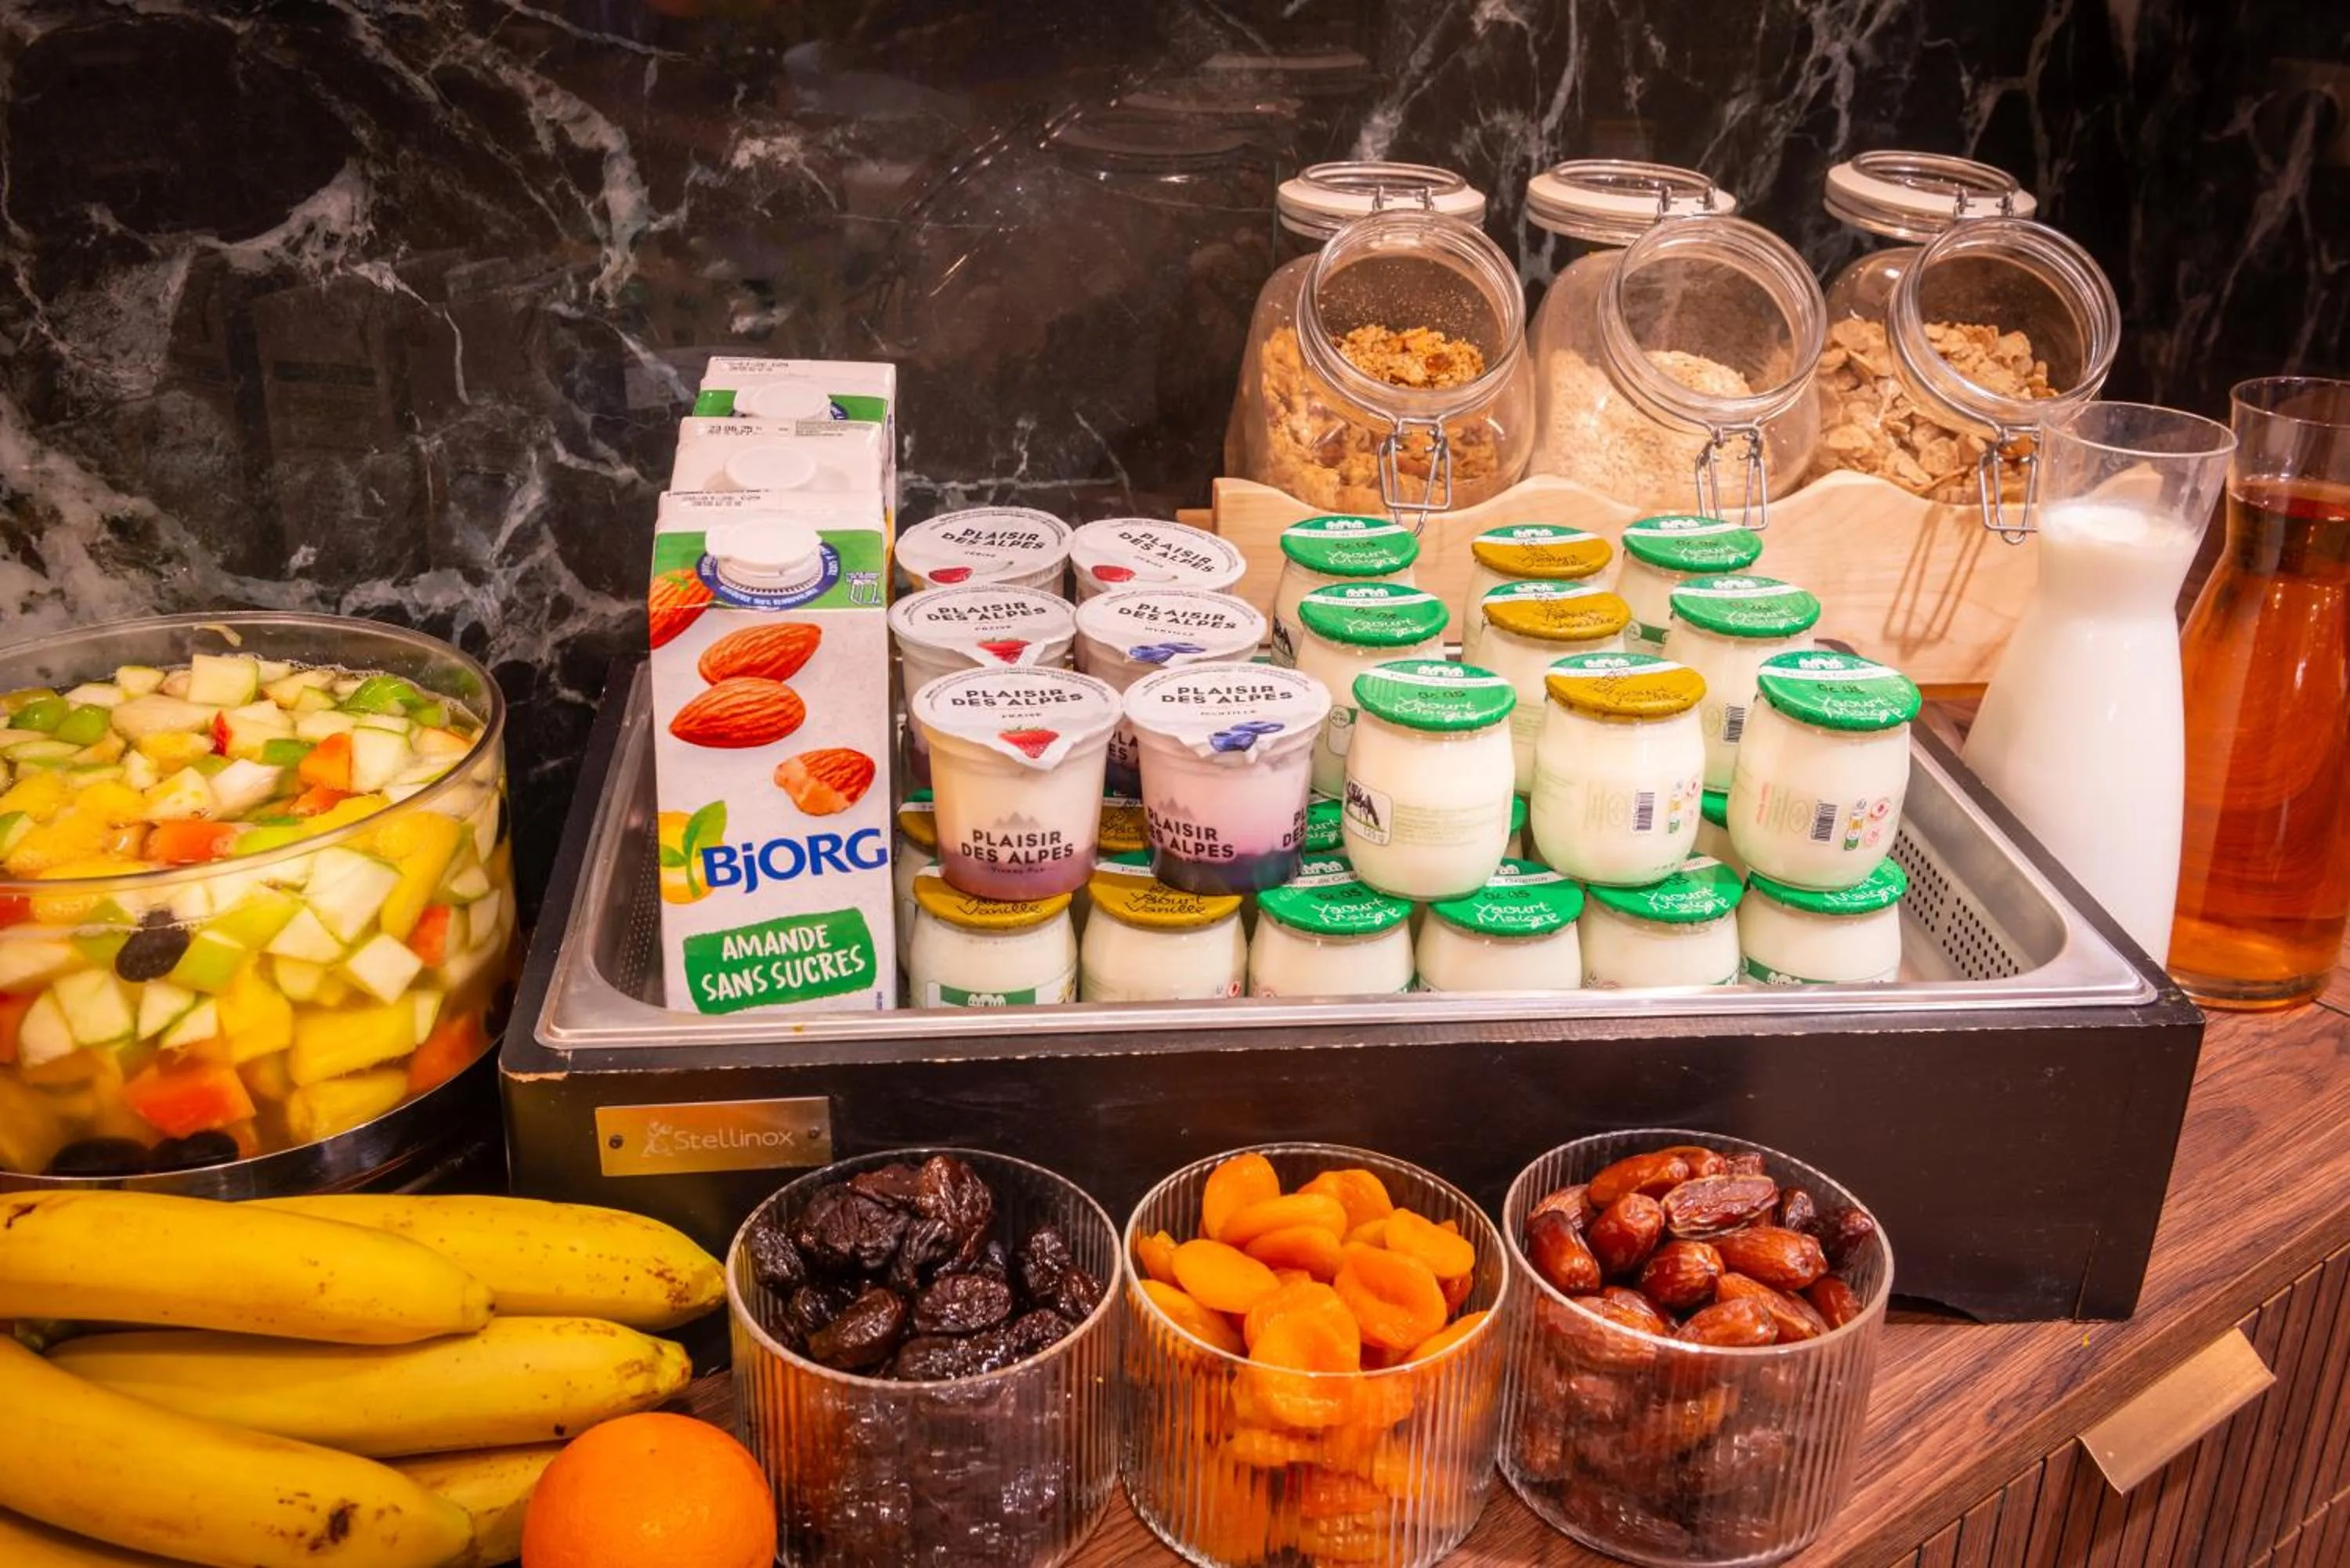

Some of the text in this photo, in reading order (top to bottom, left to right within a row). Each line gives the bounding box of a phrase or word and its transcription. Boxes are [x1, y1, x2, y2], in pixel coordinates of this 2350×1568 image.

[941, 532, 1046, 550] DES ALPES
[962, 529, 1039, 541] PLAISIR
[1119, 532, 1215, 573] DES ALPES
[1140, 532, 1213, 563] PLAISIR
[927, 607, 1047, 622] DES ALPES
[938, 602, 1027, 614] PLAISIR
[1137, 603, 1227, 621] PLAISIR
[1118, 607, 1237, 629] DES ALPES
[966, 688, 1063, 698] PLAISIR
[1162, 692, 1293, 704] DES ALPES
[1177, 685, 1274, 695] PLAISIR
[951, 693, 1084, 706] DES ALPES
[1147, 805, 1218, 842] PLAISIR
[972, 829, 1061, 847] PLAISIR
[1170, 836, 1235, 858] ALPES
[961, 842, 1074, 865] DES ALPES
[1311, 898, 1387, 915] Yaourt
[1473, 901, 1553, 915] Yaourt
[1476, 912, 1561, 930] Maigre
[722, 925, 831, 962] AMANDE
[701, 945, 866, 1002] SANS SUCRES
[673, 1126, 796, 1151] Stellinox
